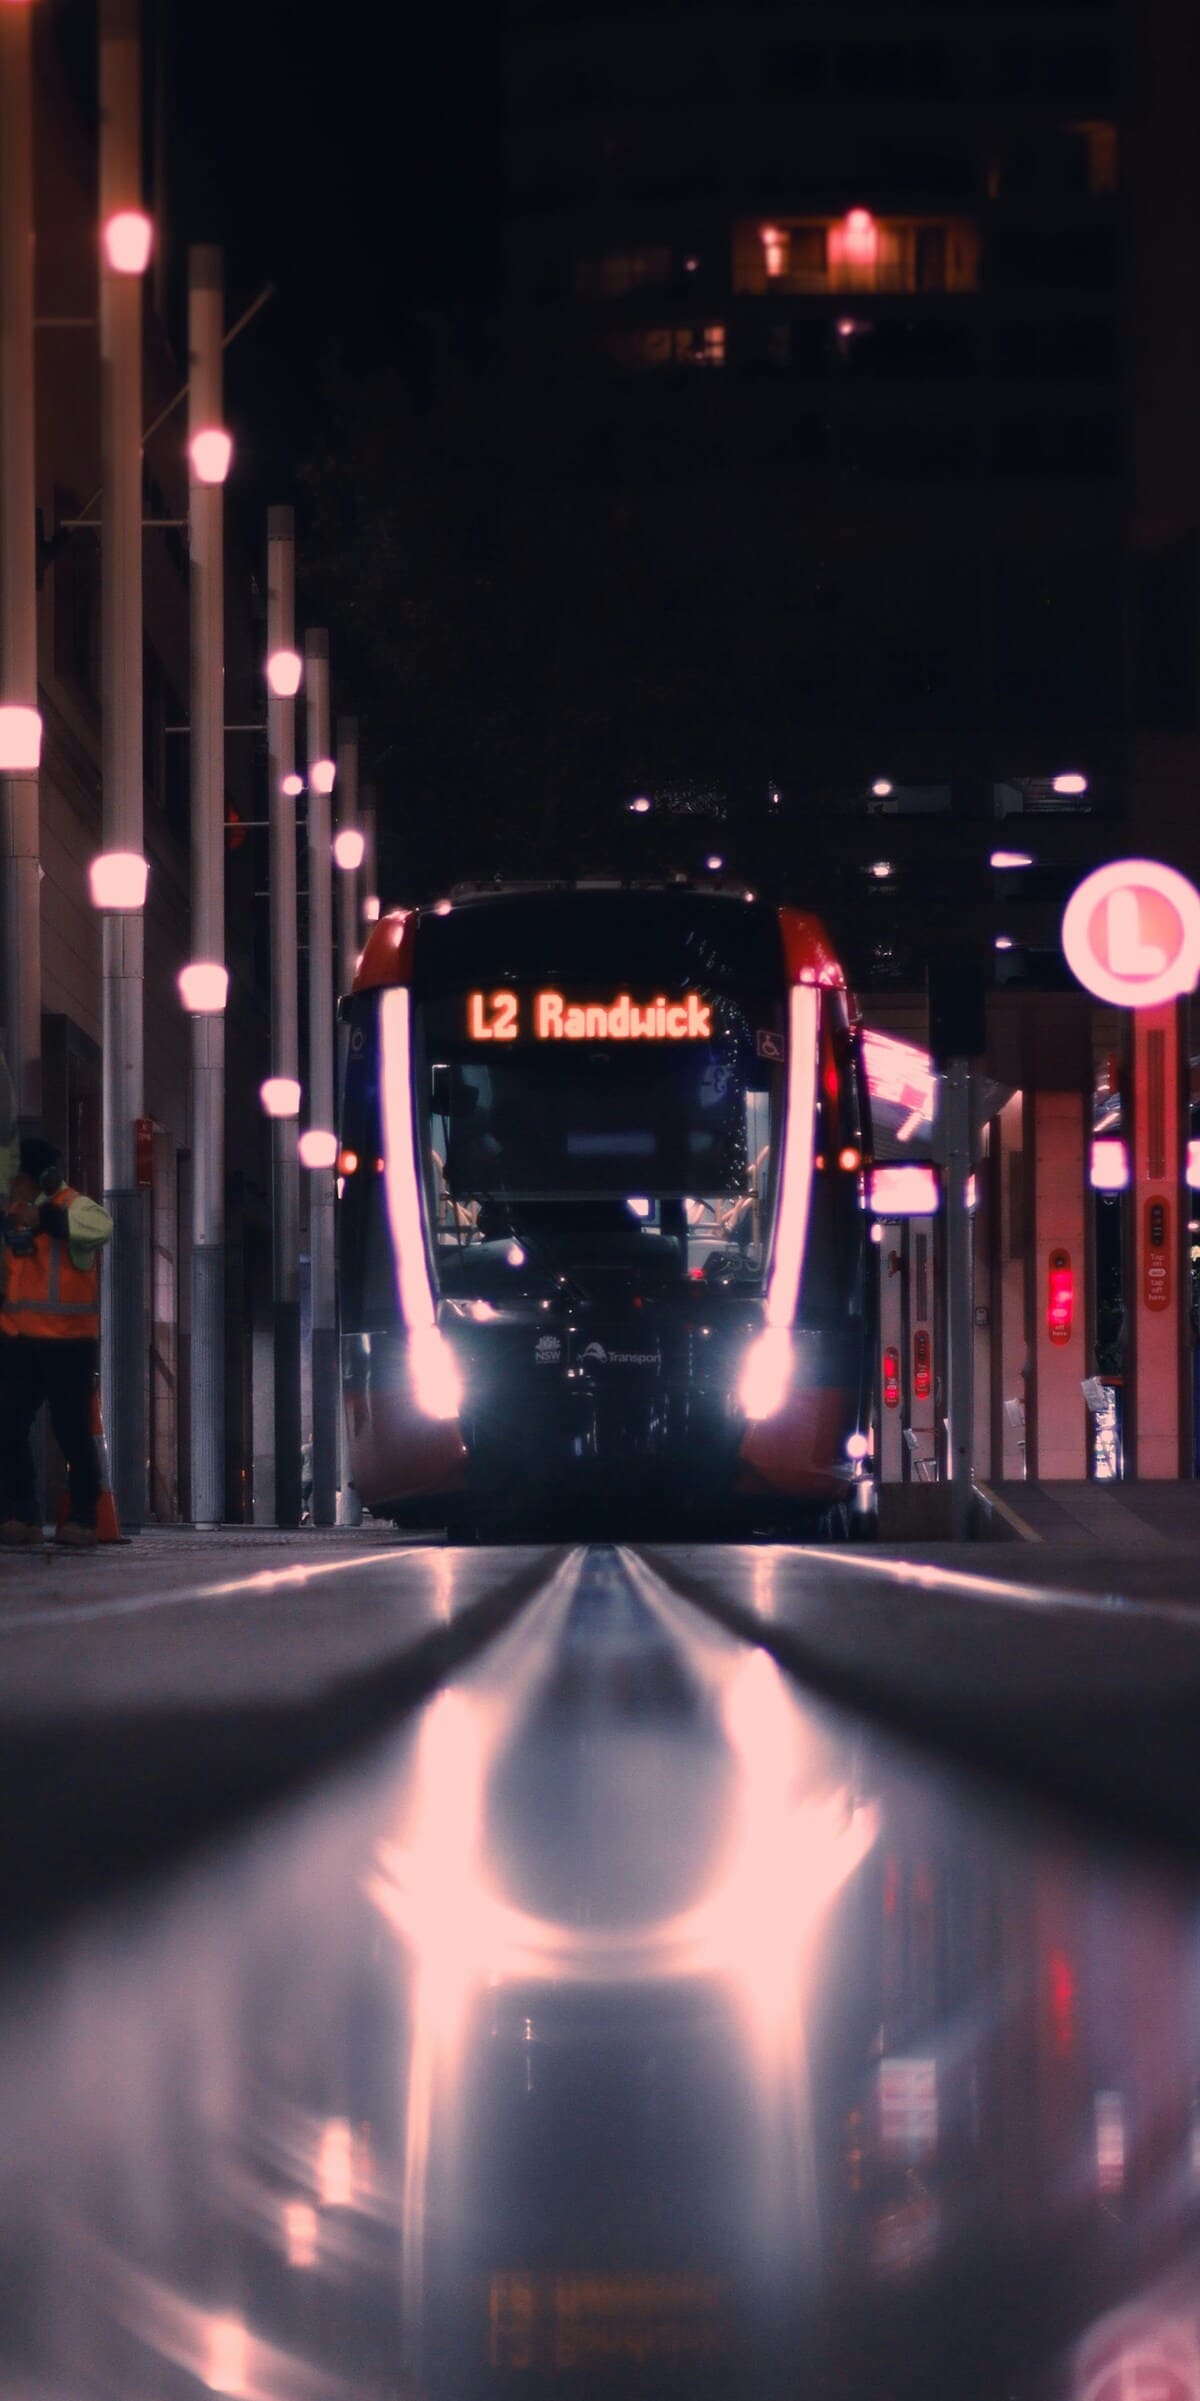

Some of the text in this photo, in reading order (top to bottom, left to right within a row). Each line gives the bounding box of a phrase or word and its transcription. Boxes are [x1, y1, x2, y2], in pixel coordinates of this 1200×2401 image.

[1107, 889, 1166, 973] L
[469, 993, 712, 1039] L2 Randwick
[535, 1351, 561, 1362] NSW
[608, 1351, 661, 1366] Transport
